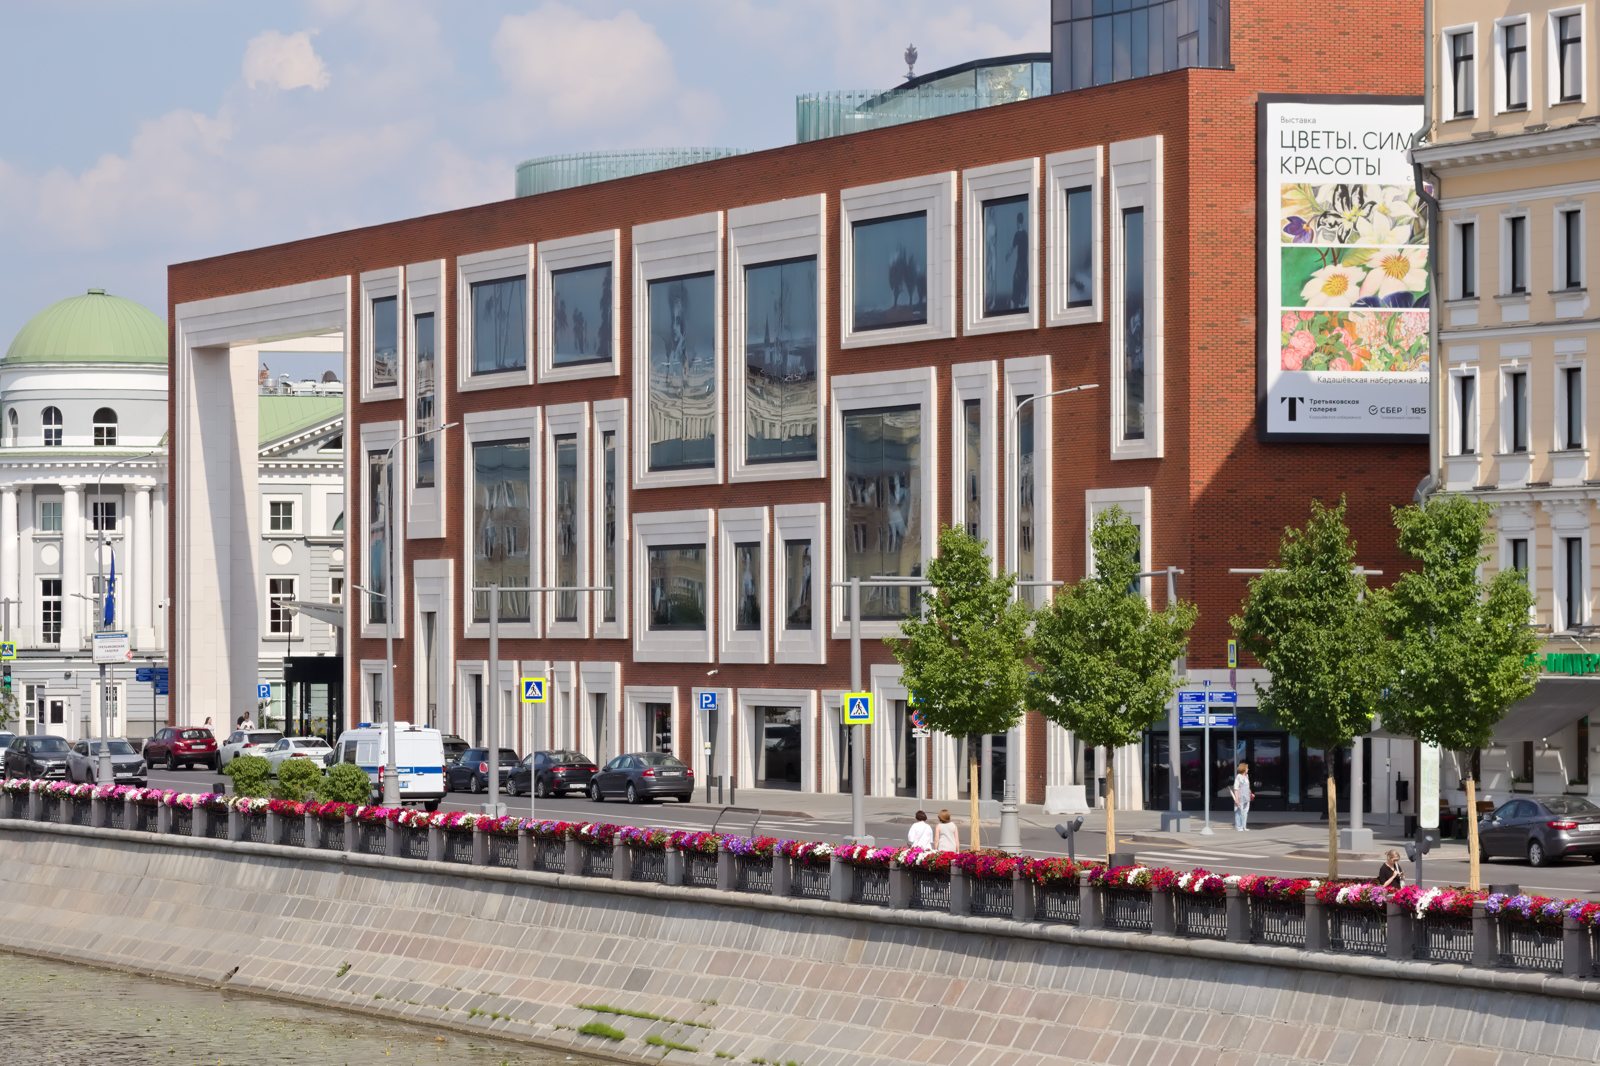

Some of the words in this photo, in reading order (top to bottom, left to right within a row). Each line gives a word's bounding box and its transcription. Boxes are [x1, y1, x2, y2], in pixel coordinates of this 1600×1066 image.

[1280, 116, 1316, 124] Выставка
[1280, 130, 1357, 152] ЦВЕТЫ.
[1280, 156, 1381, 176] КРАСОТЫ
[1317, 376, 1368, 384] Кадашёвская
[1370, 376, 1417, 385] набережная
[1380, 406, 1403, 414] СБЕР
[1411, 406, 1427, 414] 185
[702, 694, 712, 708] P
